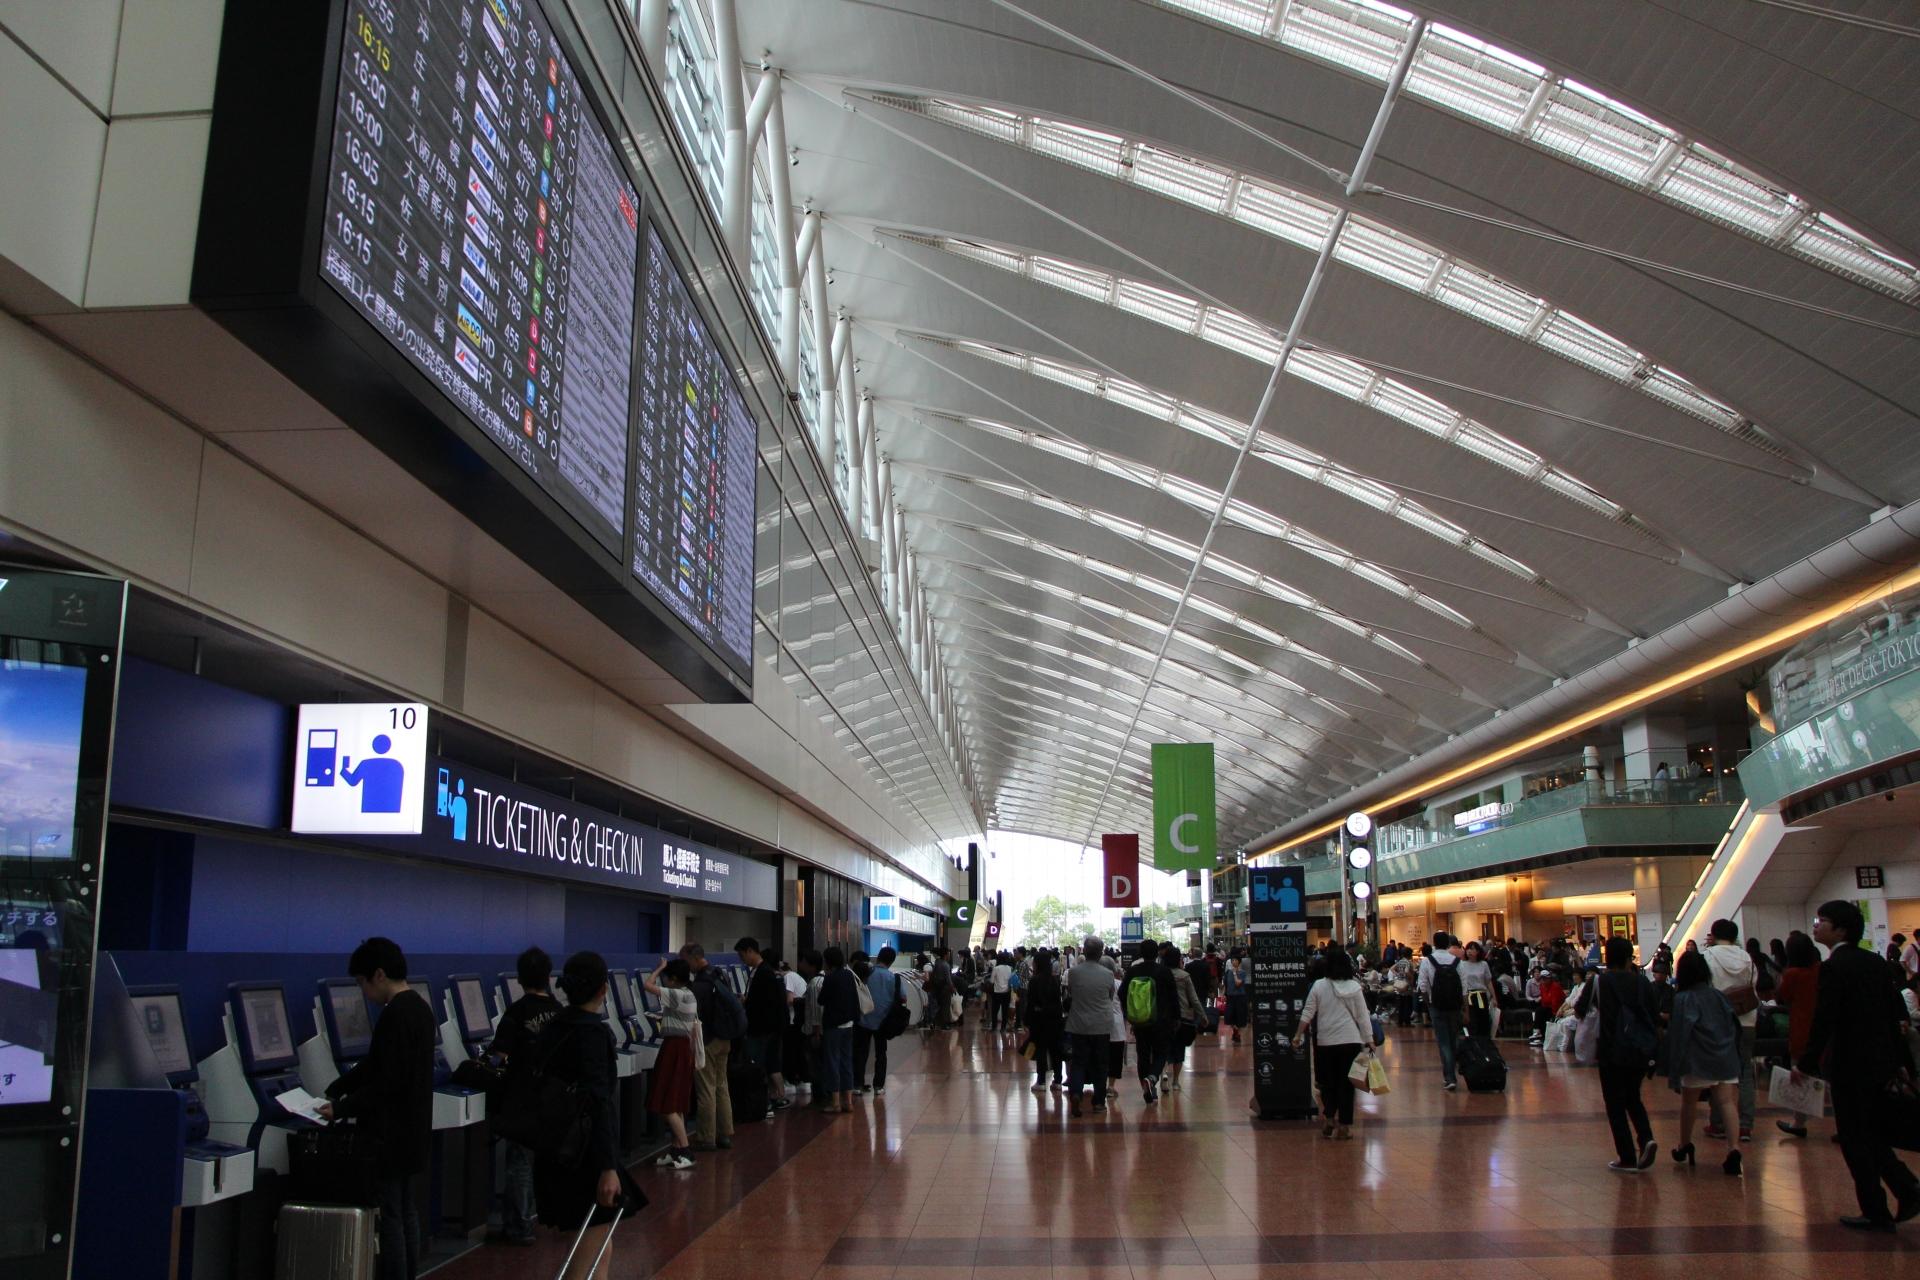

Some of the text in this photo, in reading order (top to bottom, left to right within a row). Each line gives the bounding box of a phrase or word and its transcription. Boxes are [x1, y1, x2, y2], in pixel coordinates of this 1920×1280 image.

[506, 15, 519, 50] HD
[525, 48, 535, 79] 29
[501, 74, 513, 107] 7G
[520, 106, 530, 134] 51
[504, 44, 517, 79] OZ
[523, 77, 541, 120] 9113
[556, 135, 565, 162] 70
[560, 80, 568, 107] 61
[498, 104, 510, 136] LH
[357, 11, 390, 72] 16:15
[491, 200, 504, 230] PR
[511, 228, 530, 266] 1450
[546, 276, 556, 302] 62
[496, 135, 509, 169] NH
[516, 165, 530, 200] 477
[353, 49, 386, 109] 16:00
[488, 232, 501, 262] PR
[509, 259, 527, 296] 1408
[544, 305, 554, 330] 65
[344, 128, 379, 187] 16:05
[483, 296, 497, 327] NH
[504, 321, 519, 352] 455
[348, 89, 382, 148] 16:00
[404, 157, 454, 236] 大館能代
[486, 264, 499, 295] NH
[506, 290, 521, 322] 789
[541, 333, 553, 361] 67A
[493, 167, 507, 199] NH
[513, 196, 528, 229] 397
[548, 246, 557, 272] 73
[340, 169, 375, 226] 16:15
[481, 329, 495, 360] HD
[502, 353, 513, 380] 79
[538, 394, 548, 419] 56
[335, 210, 371, 266] 16:15
[478, 363, 492, 393] PR
[500, 386, 519, 421] 1420
[537, 425, 546, 449] 60
[1849, 655, 1878, 688] DECK
[389, 707, 417, 730] 10
[473, 787, 643, 877] TICKETING & CHECK IN
[1169, 812, 1200, 854] C
[1354, 816, 1364, 832] 5
[662, 869, 679, 889] Ticketing
[1111, 875, 1132, 899] D
[0, 911, 58, 927] チする
[956, 906, 968, 921] C
[990, 925, 998, 934] D
[1255, 936, 1304, 947] TICKETING
